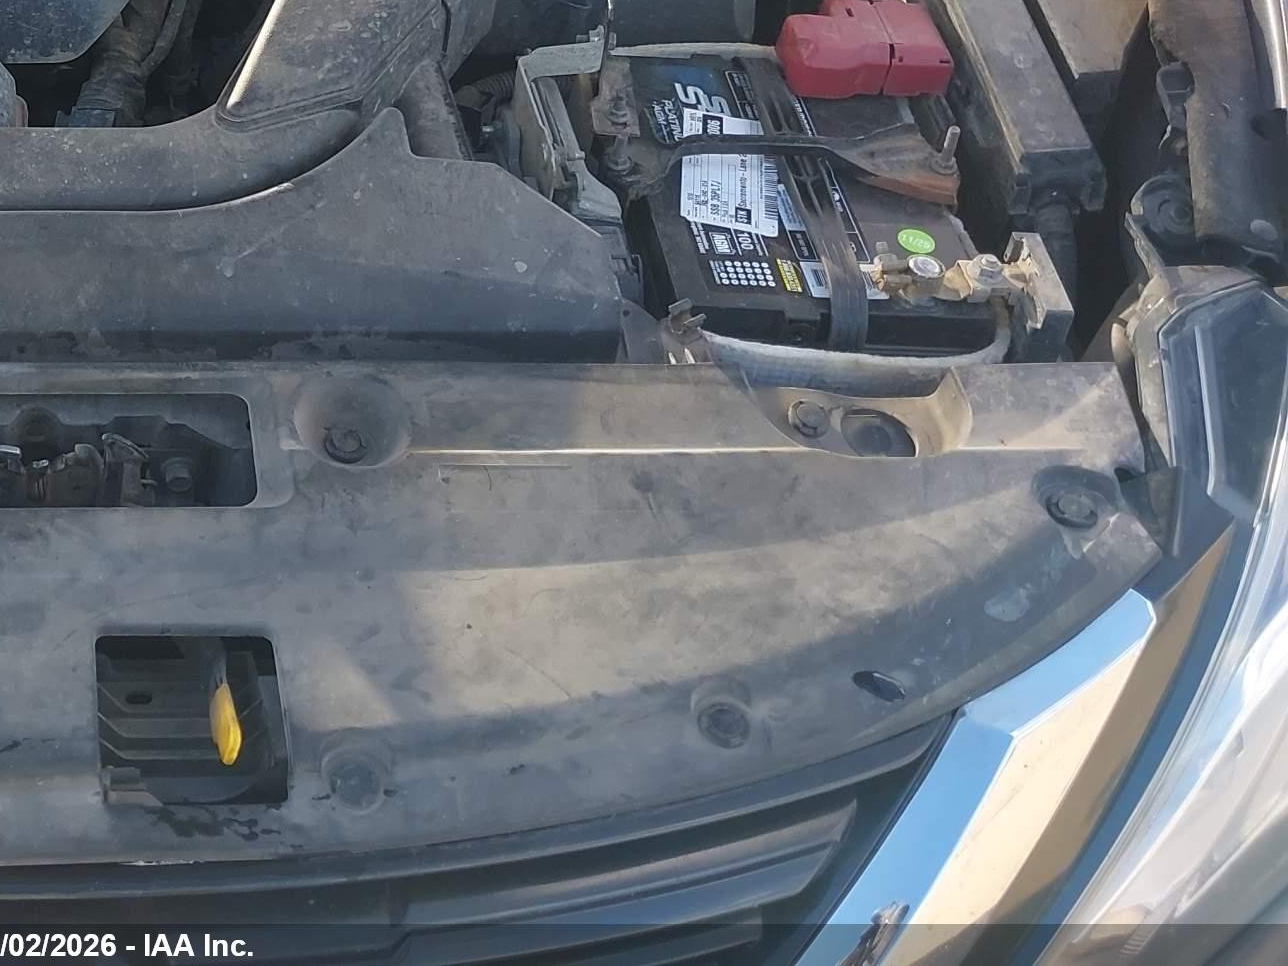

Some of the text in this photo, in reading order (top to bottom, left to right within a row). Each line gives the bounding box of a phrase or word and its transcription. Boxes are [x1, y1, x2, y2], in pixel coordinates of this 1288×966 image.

[738, 176, 748, 208] Sacramento
[712, 234, 731, 253] AGM
[737, 232, 754, 250] 100
